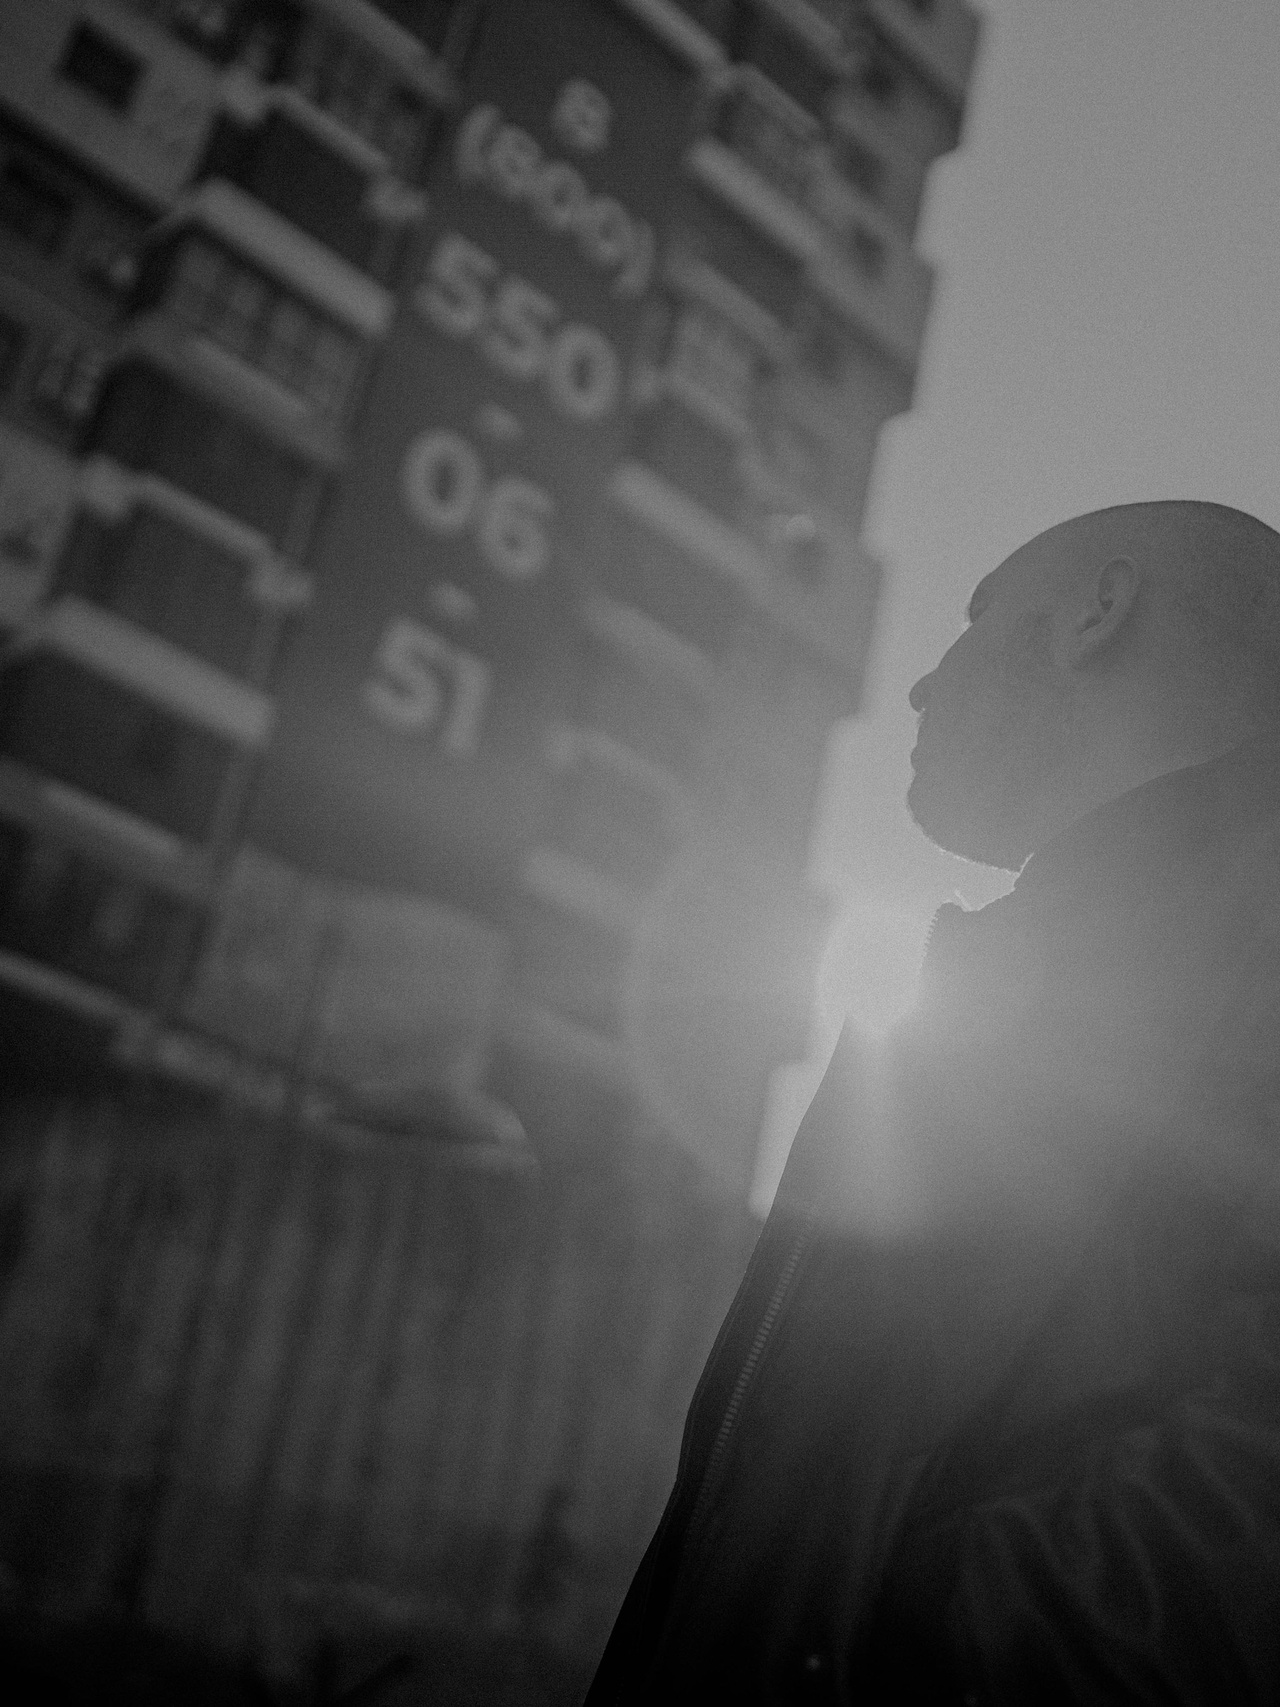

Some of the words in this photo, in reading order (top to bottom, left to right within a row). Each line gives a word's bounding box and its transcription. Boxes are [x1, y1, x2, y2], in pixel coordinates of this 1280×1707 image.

[456, 104, 653, 297] (800)
[415, 235, 619, 416] 550
[402, 430, 551, 578] 06
[366, 618, 490, 753] 51
